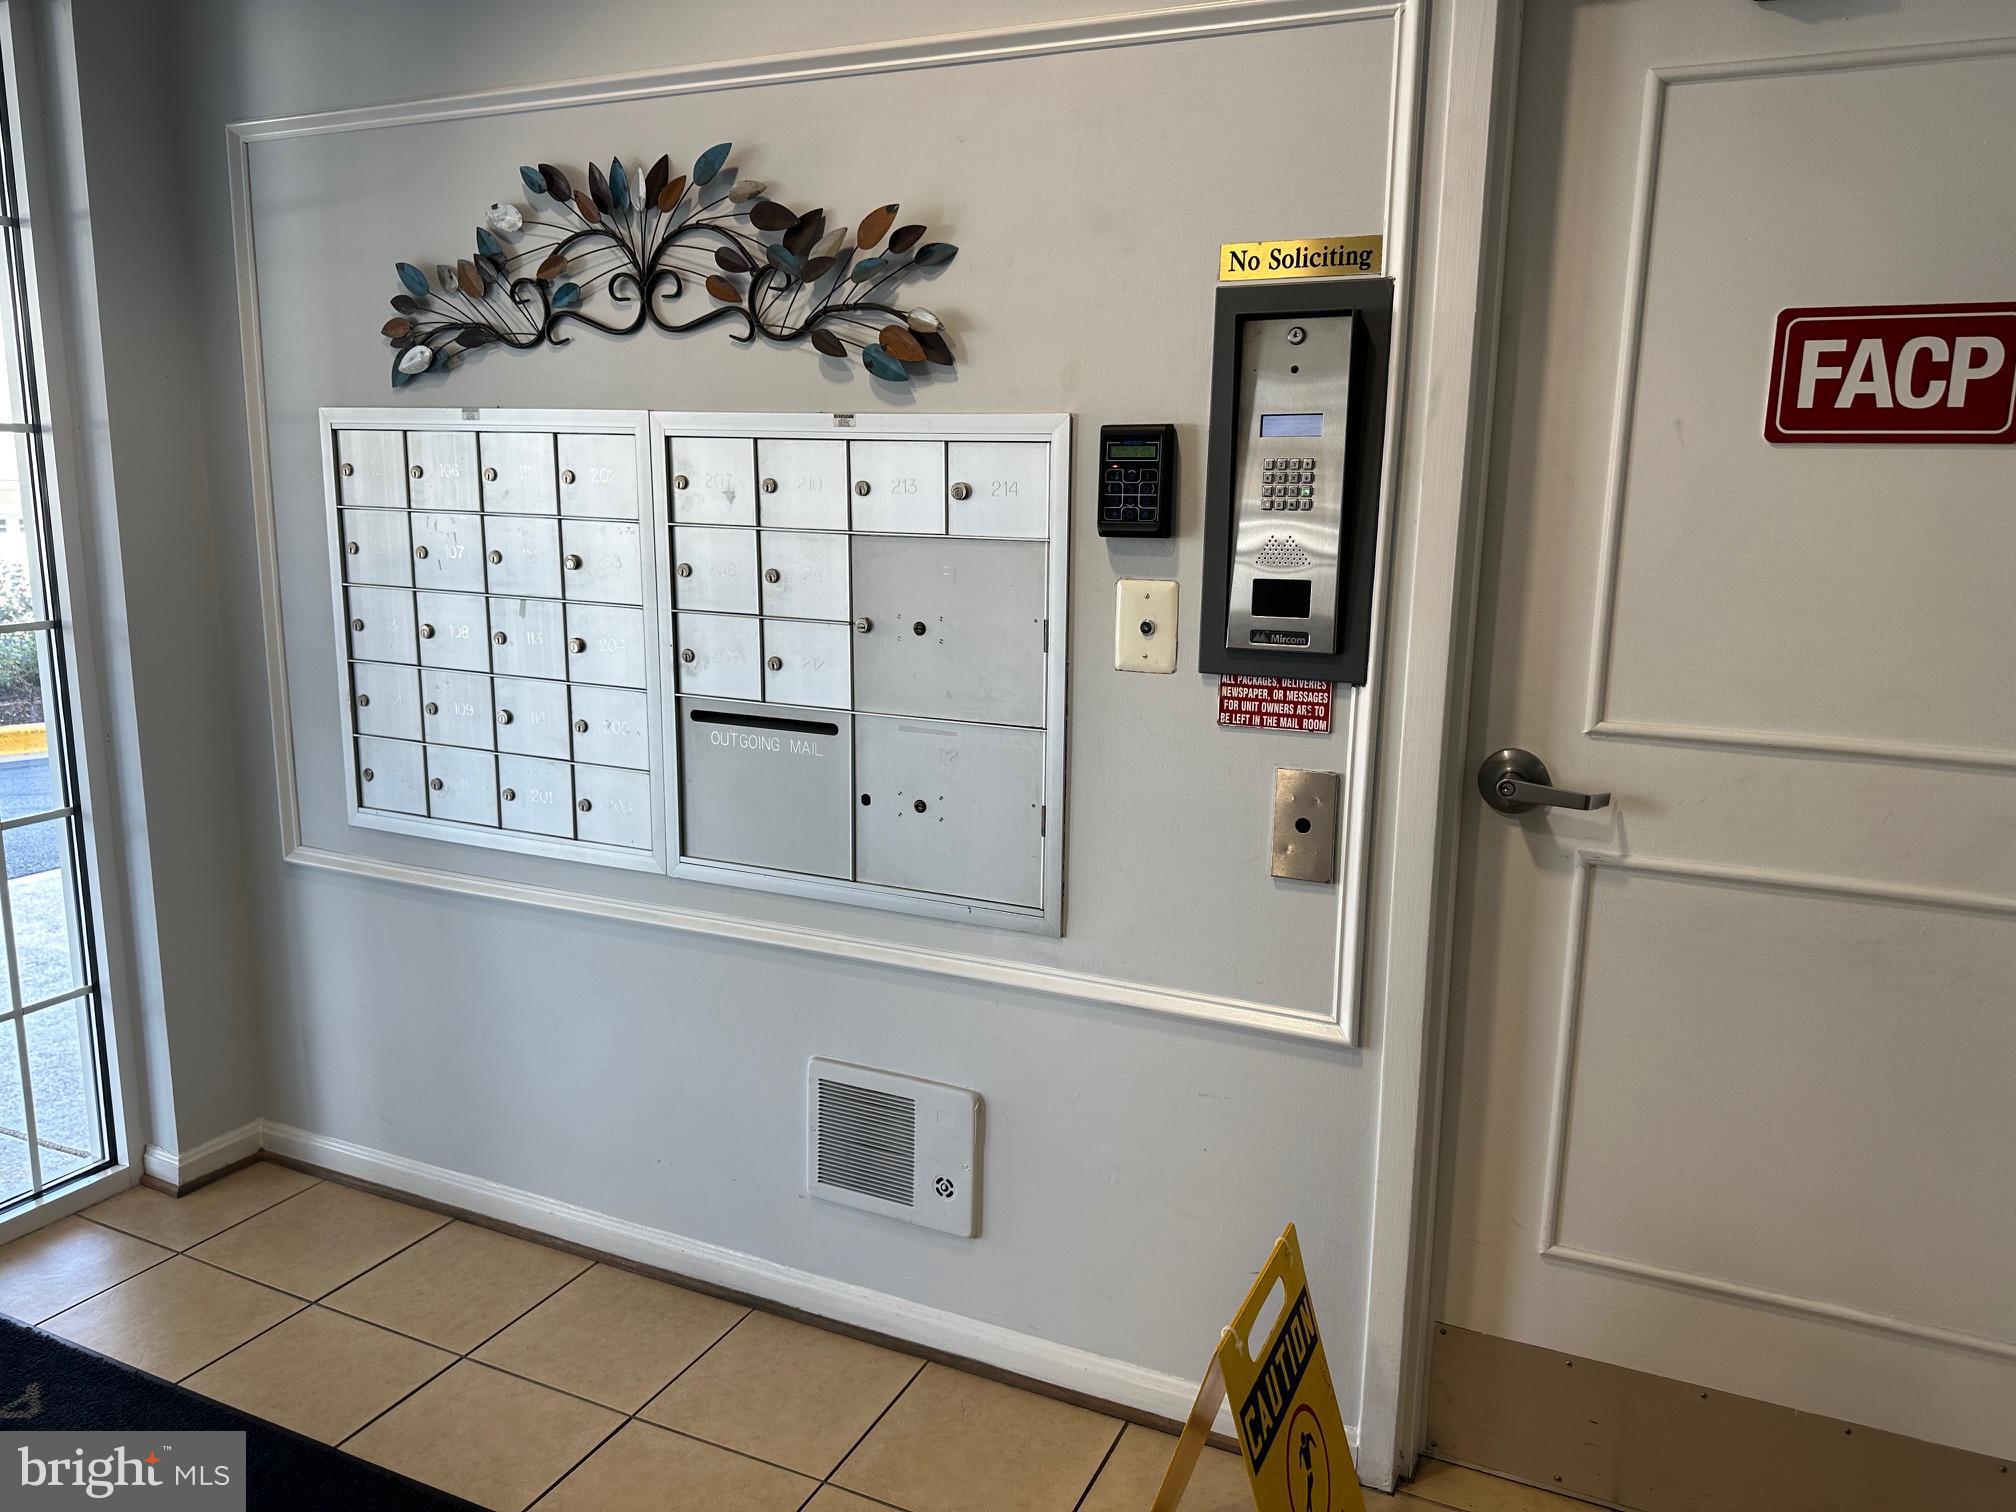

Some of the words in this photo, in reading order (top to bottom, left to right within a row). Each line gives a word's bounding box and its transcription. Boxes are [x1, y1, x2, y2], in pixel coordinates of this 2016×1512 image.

[1228, 250, 1261, 272] No
[1269, 245, 1373, 271] Soliciting
[1796, 336, 2006, 409] FACP
[704, 473, 732, 489] 207
[891, 479, 918, 495] 213
[991, 481, 1019, 496] 214
[446, 545, 465, 560] 107
[450, 624, 470, 640] 108
[1270, 634, 1306, 645] Mircom
[1221, 674, 1235, 684] ALL
[1237, 675, 1279, 688] PACKAGES,
[1221, 686, 1271, 701] NEWSPAPER,
[1273, 690, 1284, 700] OR
[1286, 691, 1329, 703] MESSAGES
[454, 702, 474, 717] 109
[1224, 700, 1239, 710] FOR
[1241, 701, 1259, 711] UNIT
[1261, 702, 1294, 715] OWNERS
[1314, 706, 1325, 717] TO
[1220, 713, 1230, 723] BE
[1232, 713, 1250, 724] LEFT
[1252, 715, 1260, 726] IN
[1263, 716, 1278, 727] THE
[1280, 717, 1299, 728] MAIL
[1303, 719, 1327, 731] ROOM
[710, 730, 780, 752] OUTGOING
[789, 739, 825, 757] MAIL
[1244, 1296, 1315, 1460] CAUTION
